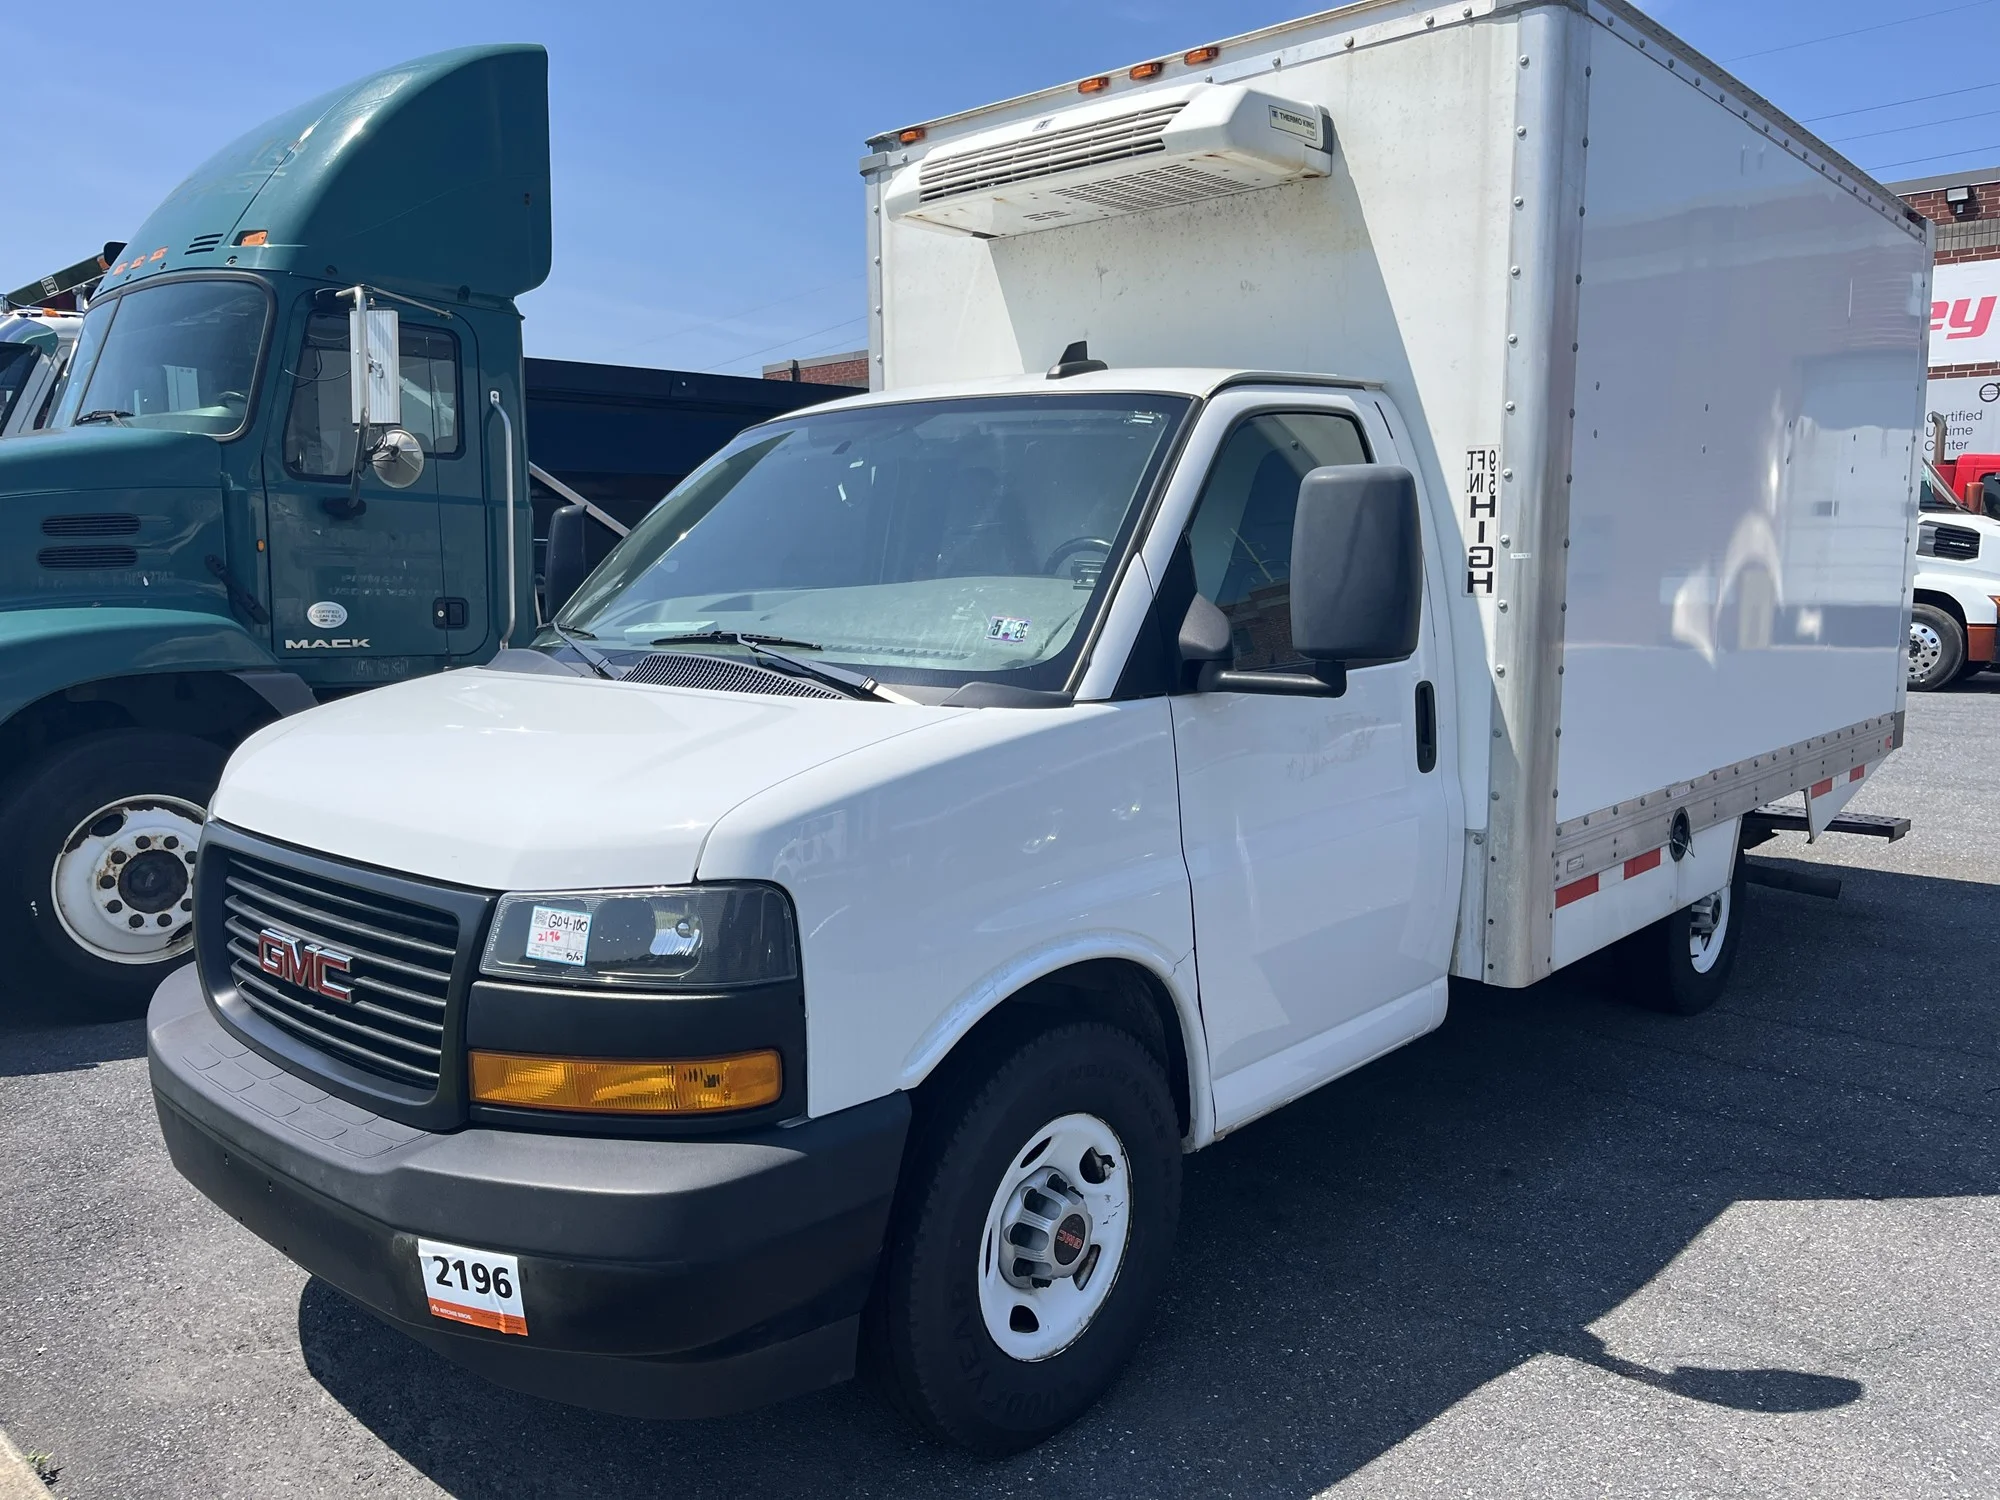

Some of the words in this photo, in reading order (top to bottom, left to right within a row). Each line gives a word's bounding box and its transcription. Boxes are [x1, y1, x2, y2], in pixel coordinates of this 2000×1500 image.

[1279, 112, 1302, 126] THERMO
[1303, 119, 1315, 130] KING
[1926, 409, 1983, 423] Crtified
[1925, 425, 1973, 438] Utime
[1924, 440, 1969, 452] Cnter
[991, 619, 1004, 636] 5
[285, 638, 371, 649] MACK
[548, 914, 588, 932] G04-100
[537, 931, 560, 942] 2196
[259, 928, 353, 1003] GMC
[1057, 1229, 1083, 1250] GMC
[433, 1255, 513, 1299] 2196
